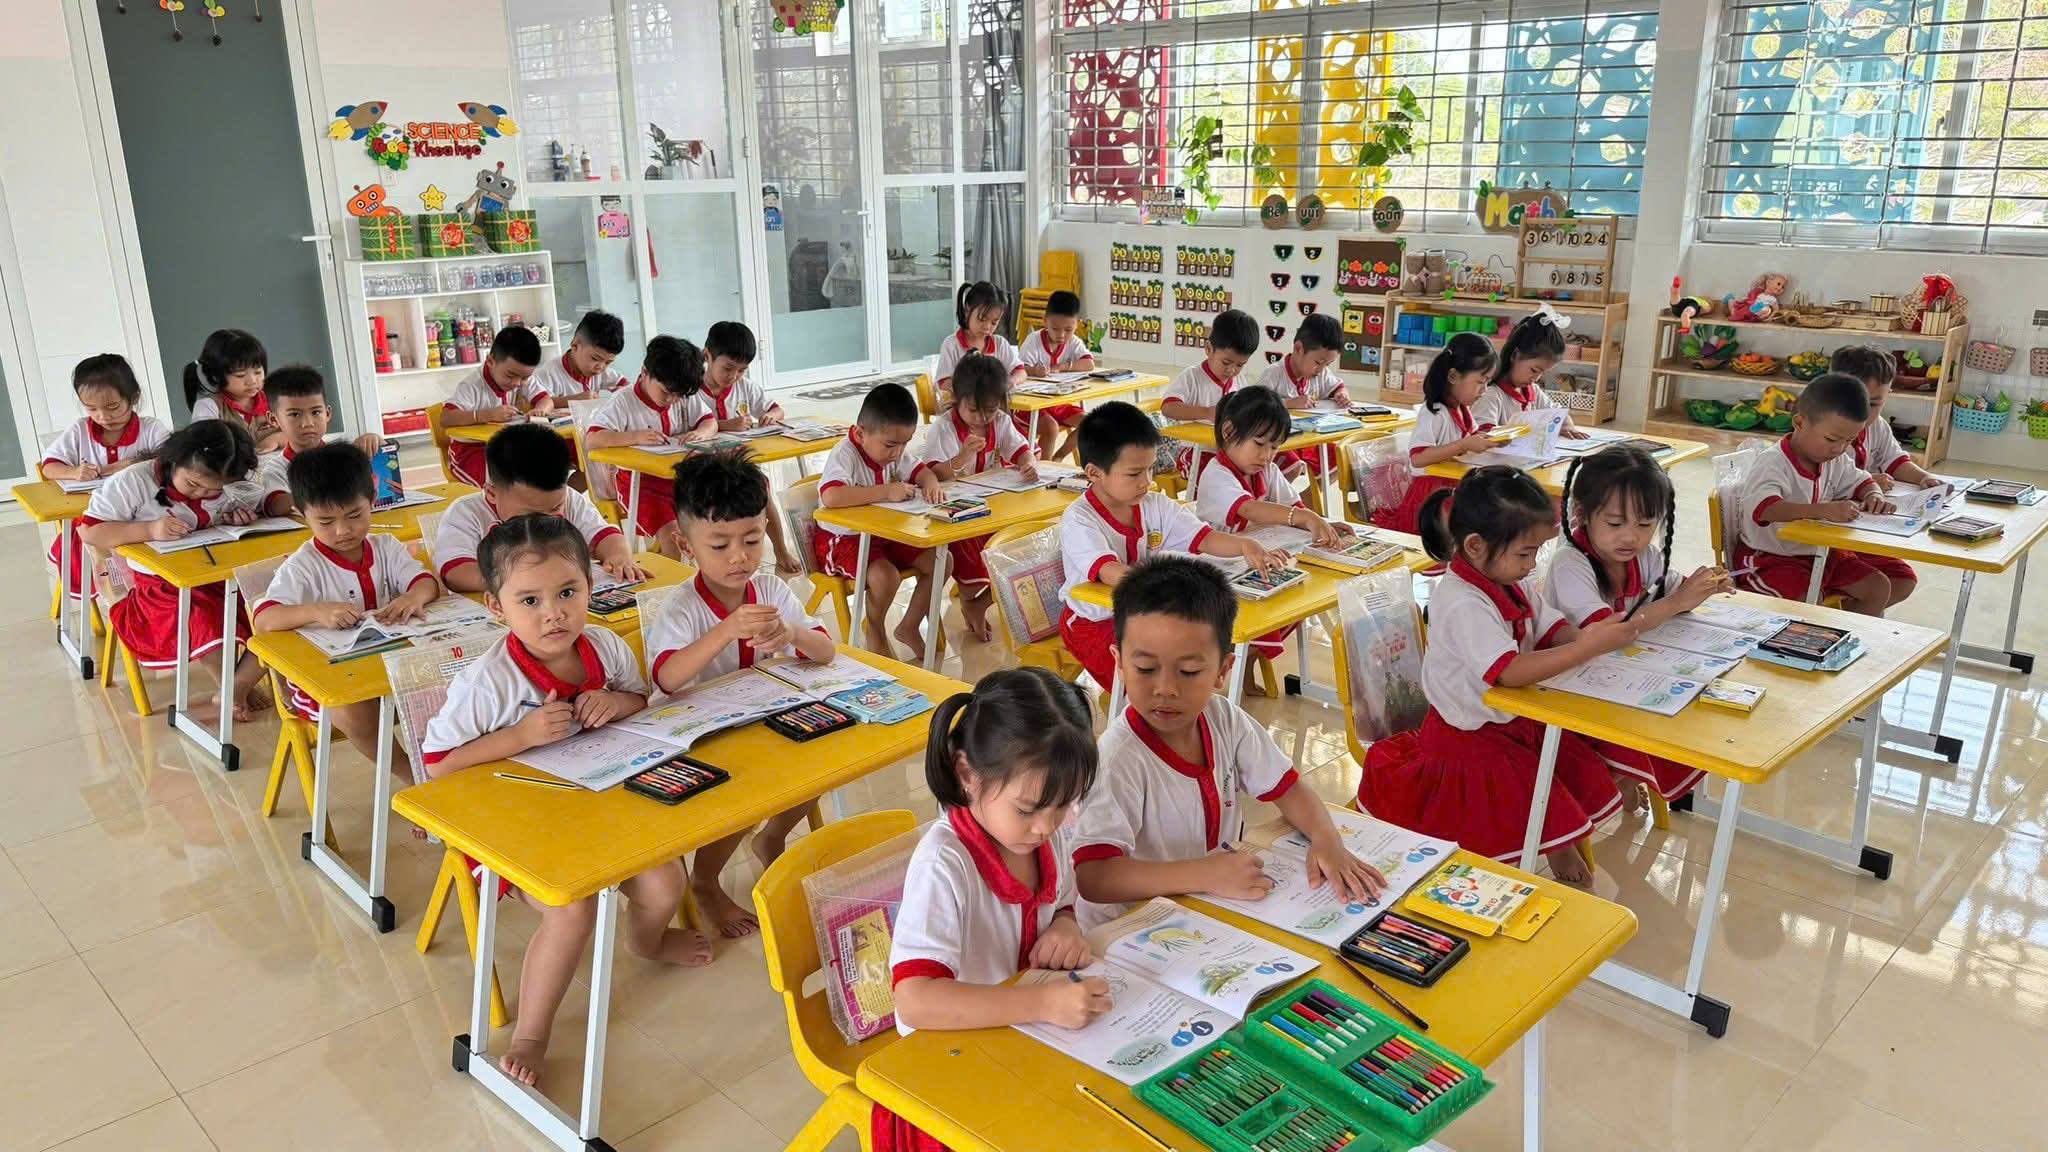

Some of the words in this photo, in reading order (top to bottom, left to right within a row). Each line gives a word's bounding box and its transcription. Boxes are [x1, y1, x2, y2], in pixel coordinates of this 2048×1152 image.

[407, 121, 480, 139] SCIENCE
[1484, 191, 1557, 227] Math
[1527, 232, 1536, 245] 3
[1541, 231, 1549, 243] 6
[1567, 232, 1580, 245] 10
[1584, 232, 1593, 244] 2
[1598, 232, 1606, 244] 4
[1567, 272, 1575, 285] 8
[1594, 272, 1603, 285] 5
[451, 646, 463, 659] 10
